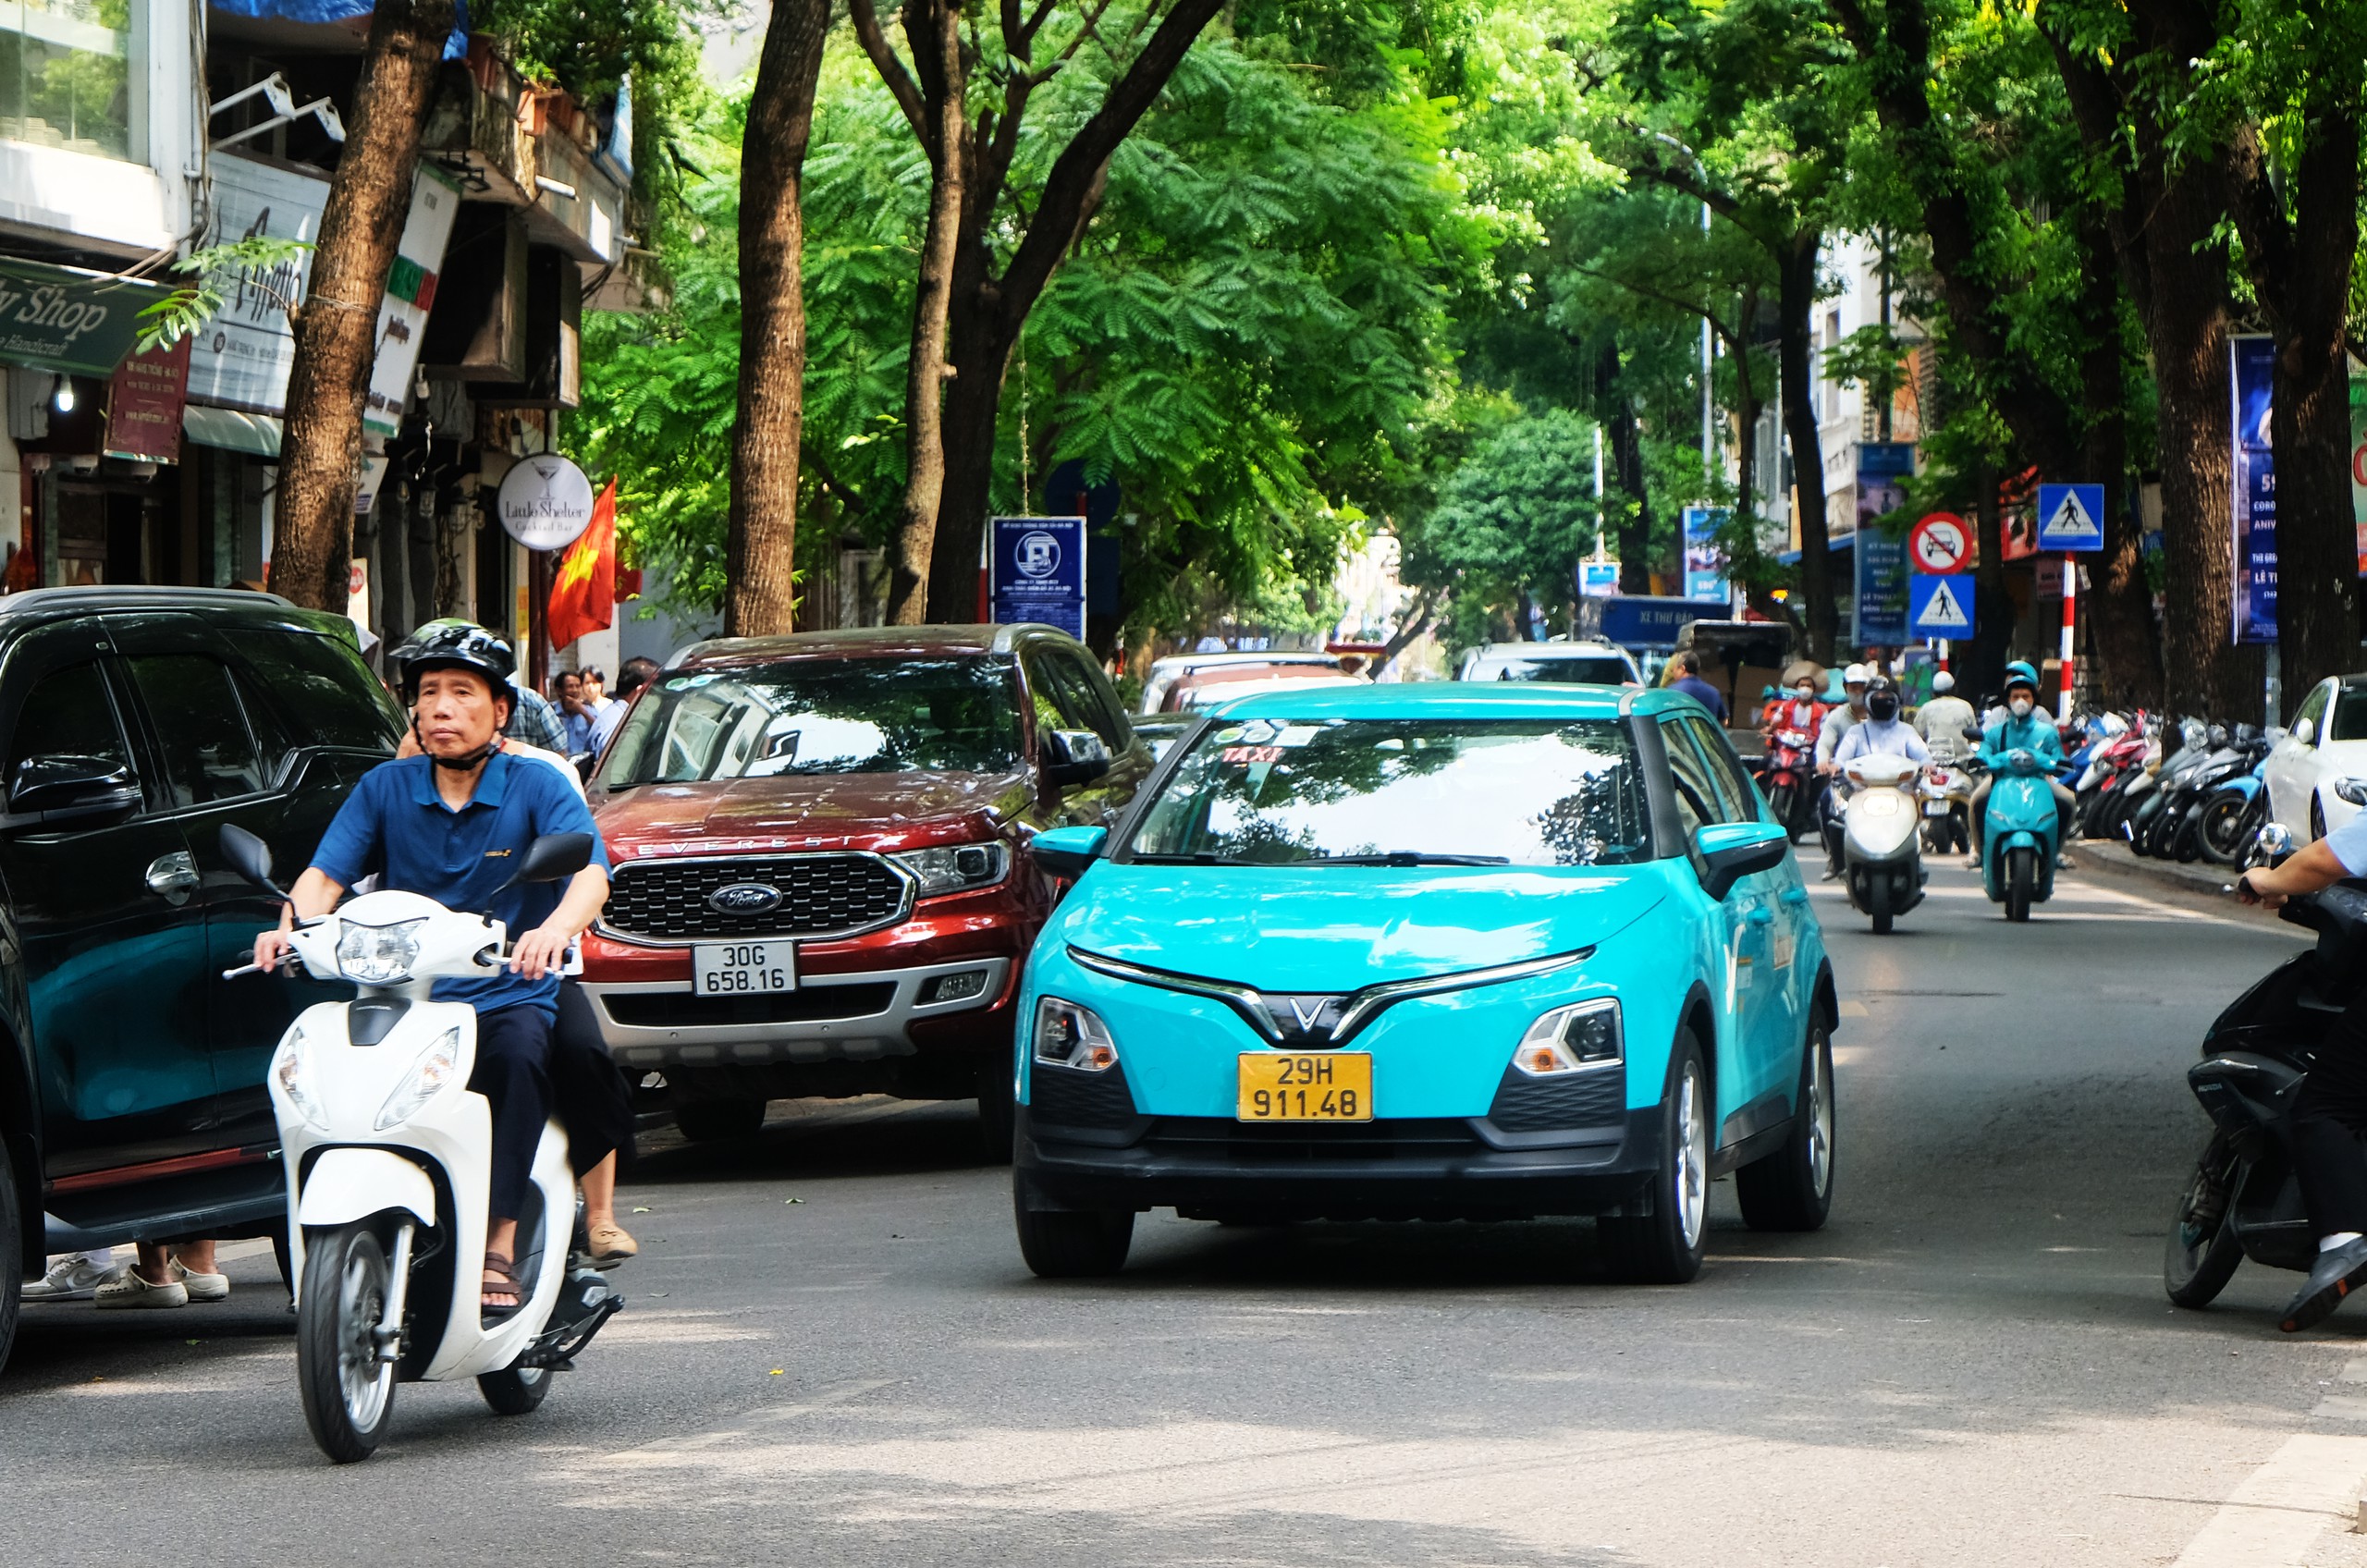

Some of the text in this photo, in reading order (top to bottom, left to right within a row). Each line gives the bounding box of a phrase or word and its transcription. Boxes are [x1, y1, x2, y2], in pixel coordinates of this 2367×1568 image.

[14, 285, 108, 341] Shop
[4, 334, 70, 356] Handicraft
[505, 500, 583, 518] Little Shelter
[2254, 569, 2266, 584] LÊ
[1222, 746, 1283, 763] TAXI
[638, 835, 856, 855] EVEREST
[726, 889, 769, 908] Ford
[722, 945, 766, 967] 30G
[706, 968, 785, 992] 658.16
[1277, 1058, 1332, 1084] 29H
[1254, 1089, 1356, 1117] 911.48
